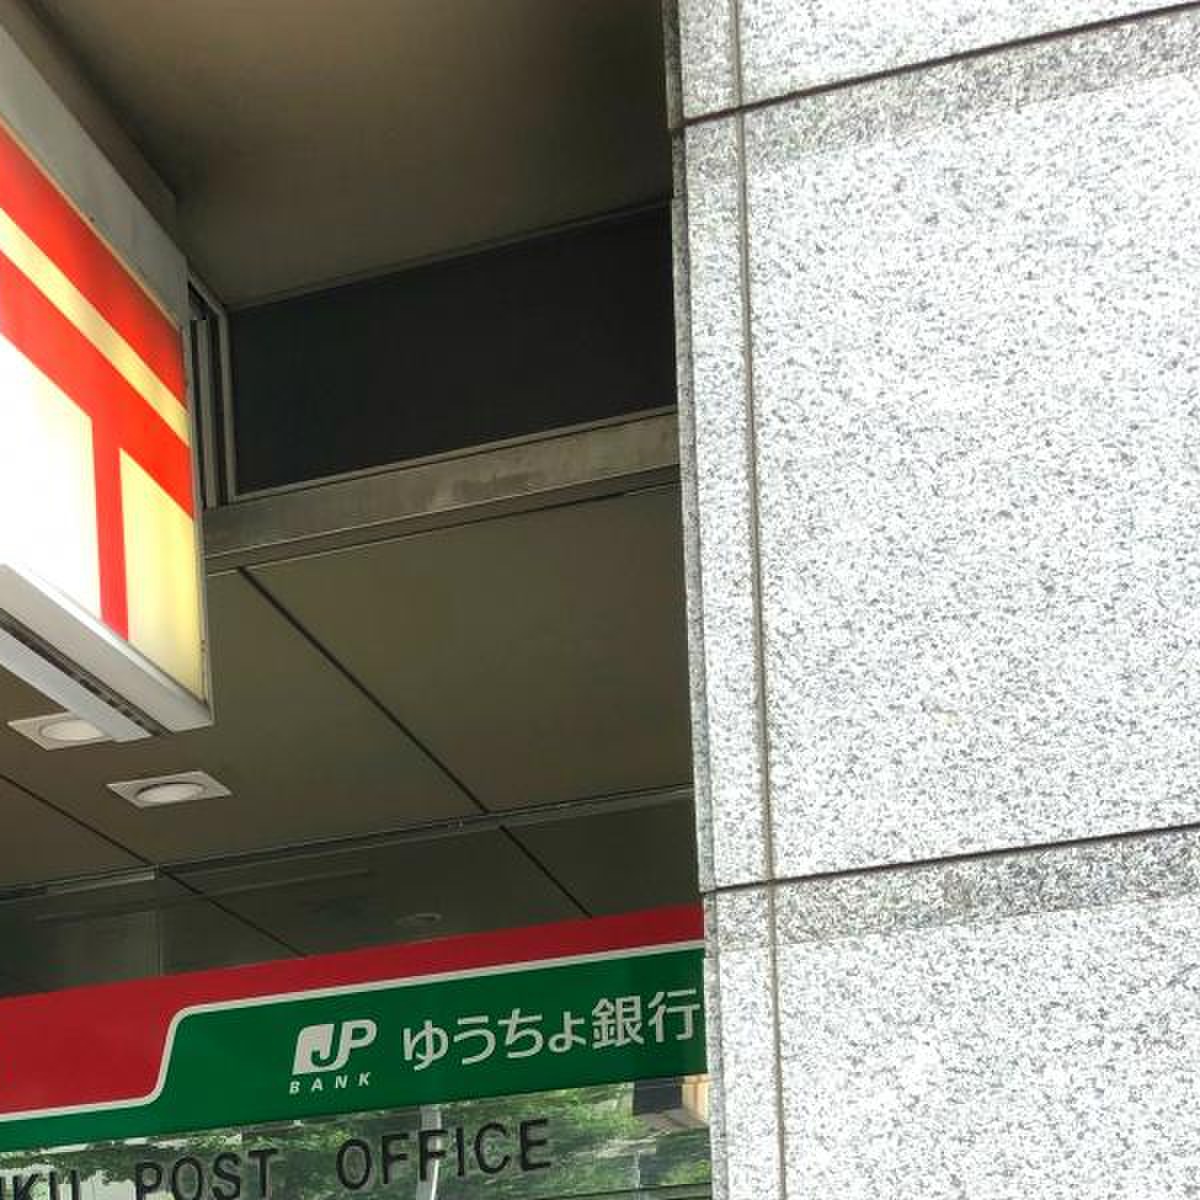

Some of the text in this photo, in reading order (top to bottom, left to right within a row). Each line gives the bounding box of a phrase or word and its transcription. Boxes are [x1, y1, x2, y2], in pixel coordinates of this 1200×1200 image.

[293, 1019, 377, 1075] JP
[403, 988, 701, 1071] ゆうちょ銀行
[288, 1072, 372, 1095] BANK
[336, 1118, 552, 1191] OFFICE
